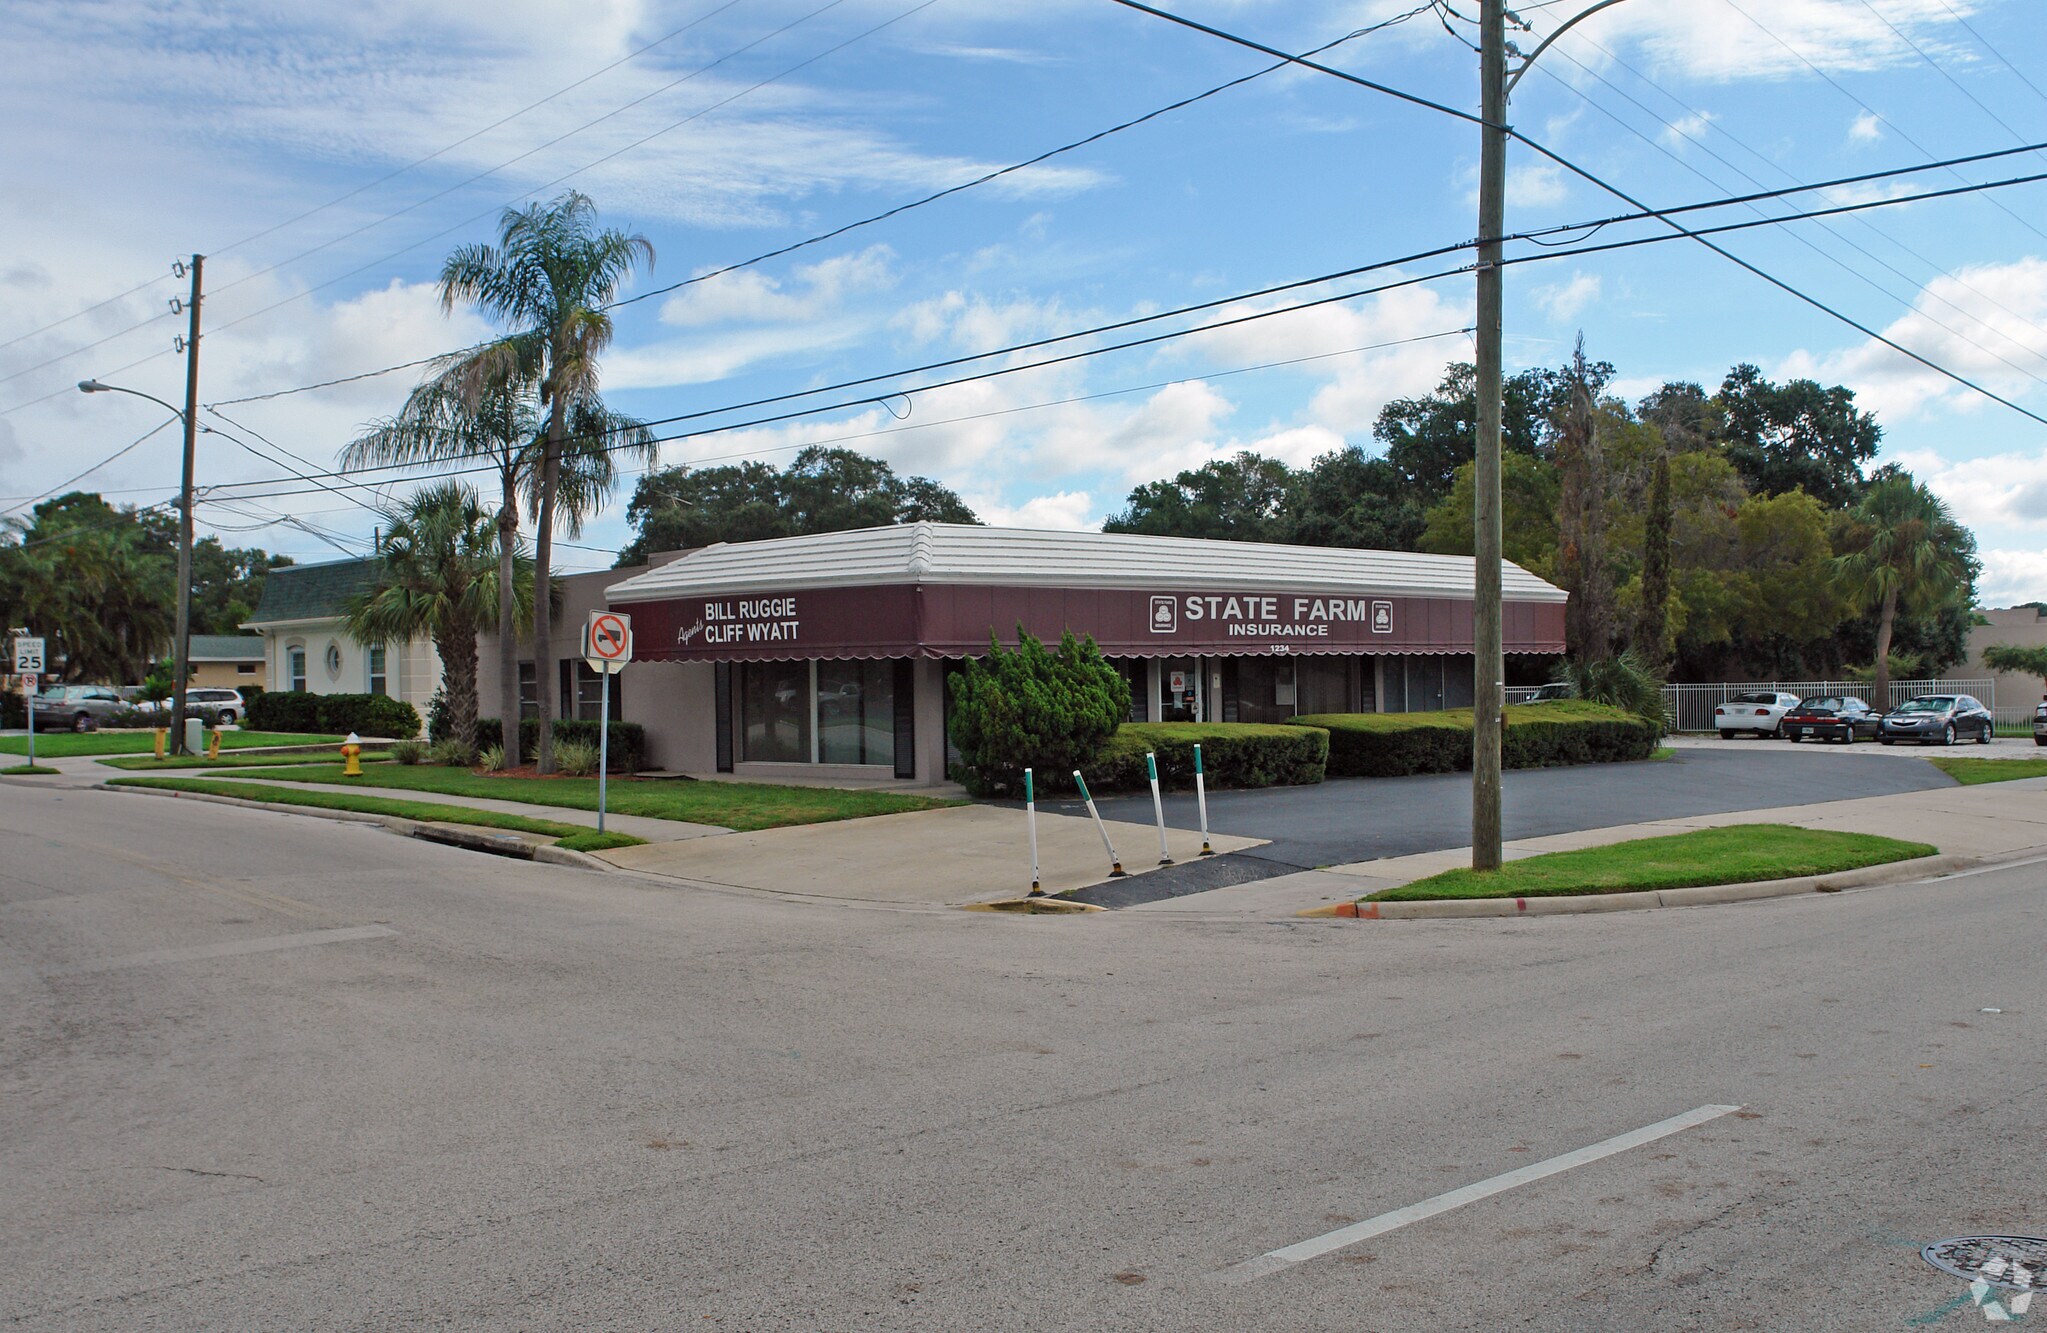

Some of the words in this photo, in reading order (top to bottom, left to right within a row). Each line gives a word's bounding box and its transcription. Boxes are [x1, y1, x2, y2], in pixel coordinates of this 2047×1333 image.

[705, 602, 736, 621] BILL
[739, 597, 797, 619] RUGGIE
[1185, 596, 1278, 620] STATE
[1294, 598, 1366, 622] FARM
[677, 617, 704, 645] Agents
[705, 624, 743, 643] CLIFF
[747, 621, 799, 641] WYATT
[1229, 623, 1328, 636] INSURANCE
[1270, 644, 1290, 652] 1234
[18, 656, 41, 669] 25
